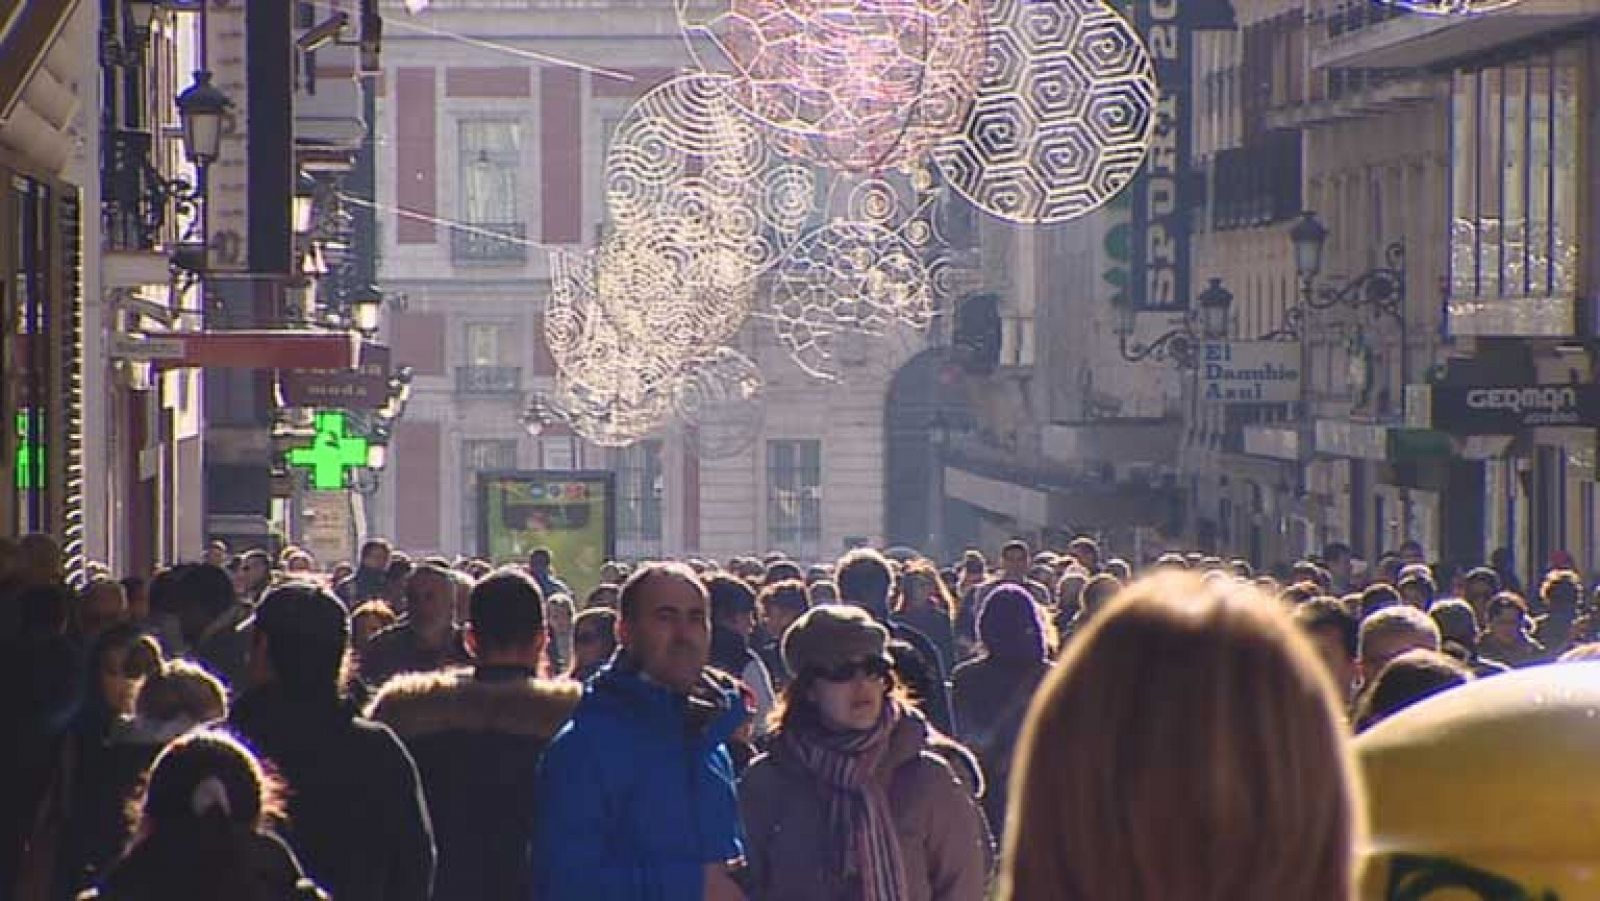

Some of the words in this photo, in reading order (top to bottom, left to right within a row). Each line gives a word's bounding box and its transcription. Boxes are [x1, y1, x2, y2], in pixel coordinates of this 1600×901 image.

[1147, 92, 1176, 304] SPORT
[1205, 343, 1232, 361] El
[1205, 363, 1299, 381] Danubio
[1205, 383, 1264, 400] Azul
